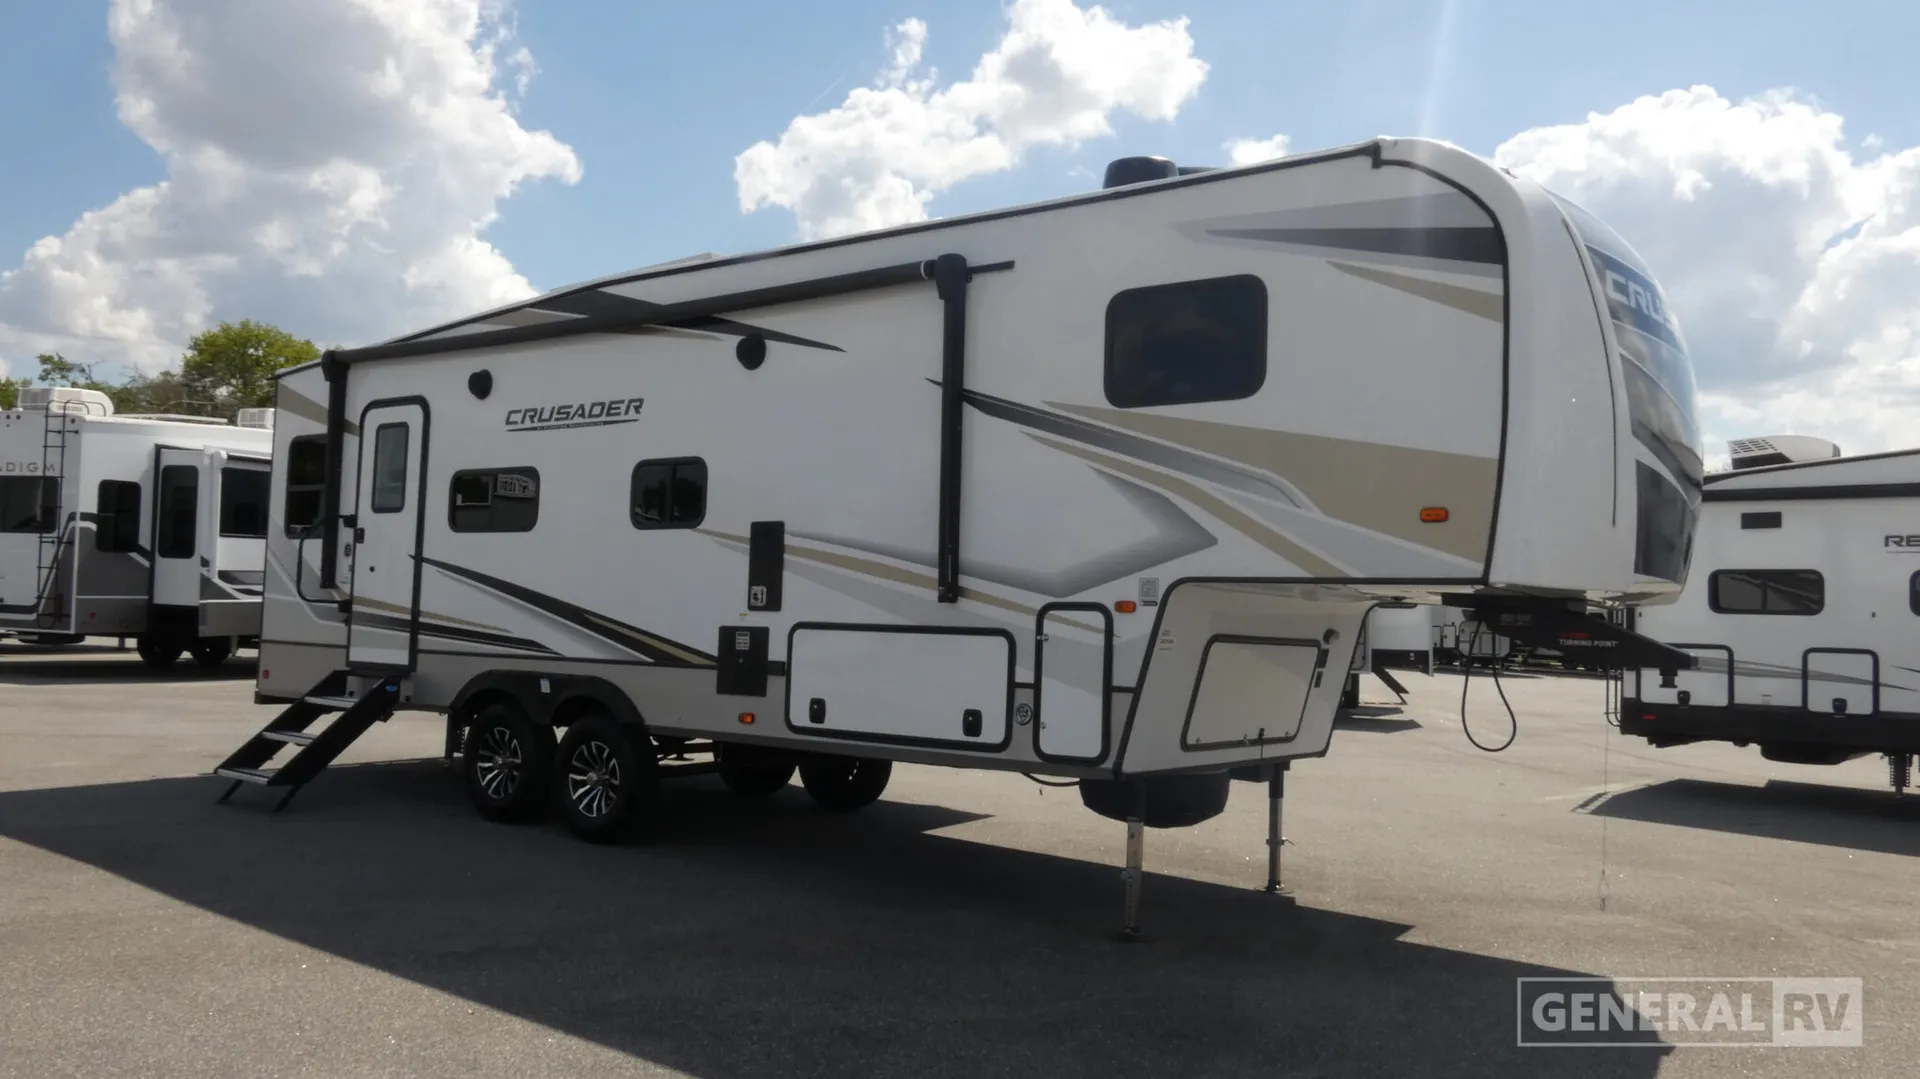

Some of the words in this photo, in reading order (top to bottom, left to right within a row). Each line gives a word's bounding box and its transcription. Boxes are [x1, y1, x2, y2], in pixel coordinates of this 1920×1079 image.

[505, 397, 645, 426] CRUSADER
[0, 461, 56, 474] DIGM
[1559, 639, 1593, 647] TURNING
